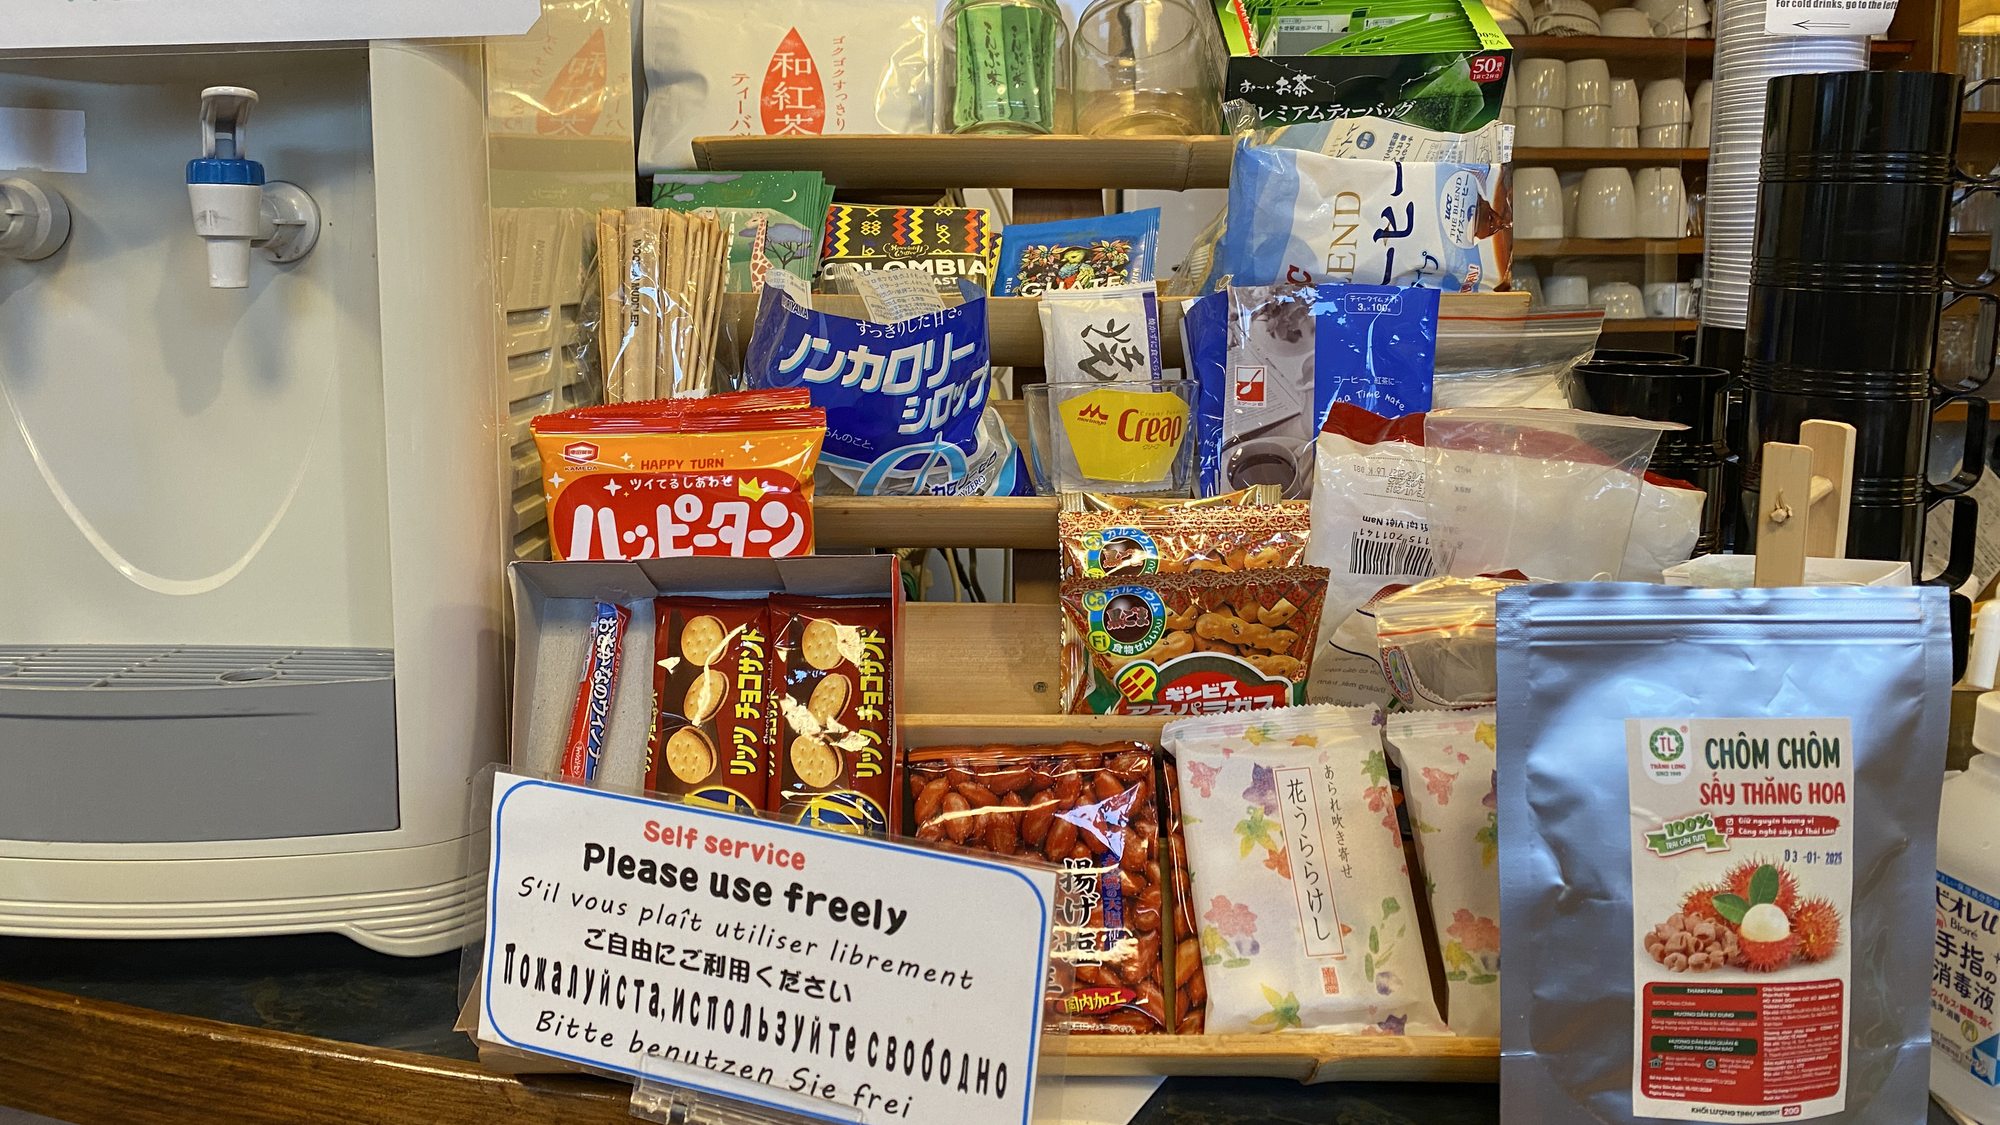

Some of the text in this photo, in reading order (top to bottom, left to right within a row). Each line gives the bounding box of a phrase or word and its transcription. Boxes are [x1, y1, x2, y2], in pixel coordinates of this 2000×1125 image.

[1776, 0, 1789, 8] For
[1792, 0, 1811, 8] cold
[1813, 0, 1844, 9] drinks,
[1846, 1, 1857, 9] go
[1858, 0, 1867, 8] to
[1868, 0, 1881, 9] the
[729, 72, 751, 136] ティーバ
[771, 52, 817, 135] 和紅茶
[832, 36, 847, 131] ゴクゴクすっきり
[1255, 100, 1417, 122] レミアムティーバッグ
[1450, 176, 1462, 238] THE BLEND
[1326, 191, 1362, 283] END
[778, 332, 976, 395] ノンカロリー
[1148, 317, 1162, 391] 焼かずに食べられ
[897, 359, 990, 436] シロップ
[824, 425, 875, 451] ろんのこと、
[1117, 408, 1183, 448] Creap
[630, 475, 733, 491] ツイてるしあわせ
[641, 458, 725, 471] HAPPY TURN
[566, 493, 804, 560] ハッピーターン
[1359, 528, 1403, 541] 701141
[1362, 515, 1383, 526] Nam
[1086, 593, 1106, 607] Ca
[1109, 586, 1160, 613] カルシウム
[1093, 632, 1107, 648] Fi
[1112, 618, 1163, 655] 食物せんい入り
[730, 629, 766, 777] リッツ チョコサンド
[1165, 680, 1240, 701] ギンビス
[1659, 737, 1675, 752] TL
[1705, 730, 1841, 770] CHÔM CHÔM
[1700, 772, 1846, 806] SẤY THĂNG HOA
[644, 820, 806, 871] Self service
[1324, 764, 1353, 880] あられ吹き寄せ
[1664, 814, 1713, 838] 100%
[1287, 778, 1331, 942] 花うららけし
[583, 843, 908, 935] Please use freely
[1059, 858, 1102, 967] 揚げ塩
[518, 876, 974, 990] S'il vous plaît utiliser librement
[1950, 916, 1979, 940] Bioré
[584, 928, 852, 1003] ご自由にご利用ください
[1935, 929, 1997, 985] 手指の
[1063, 990, 1127, 1013] 国内加工
[1933, 958, 1996, 1015] 消毒液
[536, 1010, 914, 1118] Bitte benutzen Sie frei
[867, 1030, 1008, 1099] свободно
[1784, 1107, 1801, 1115] 20G
